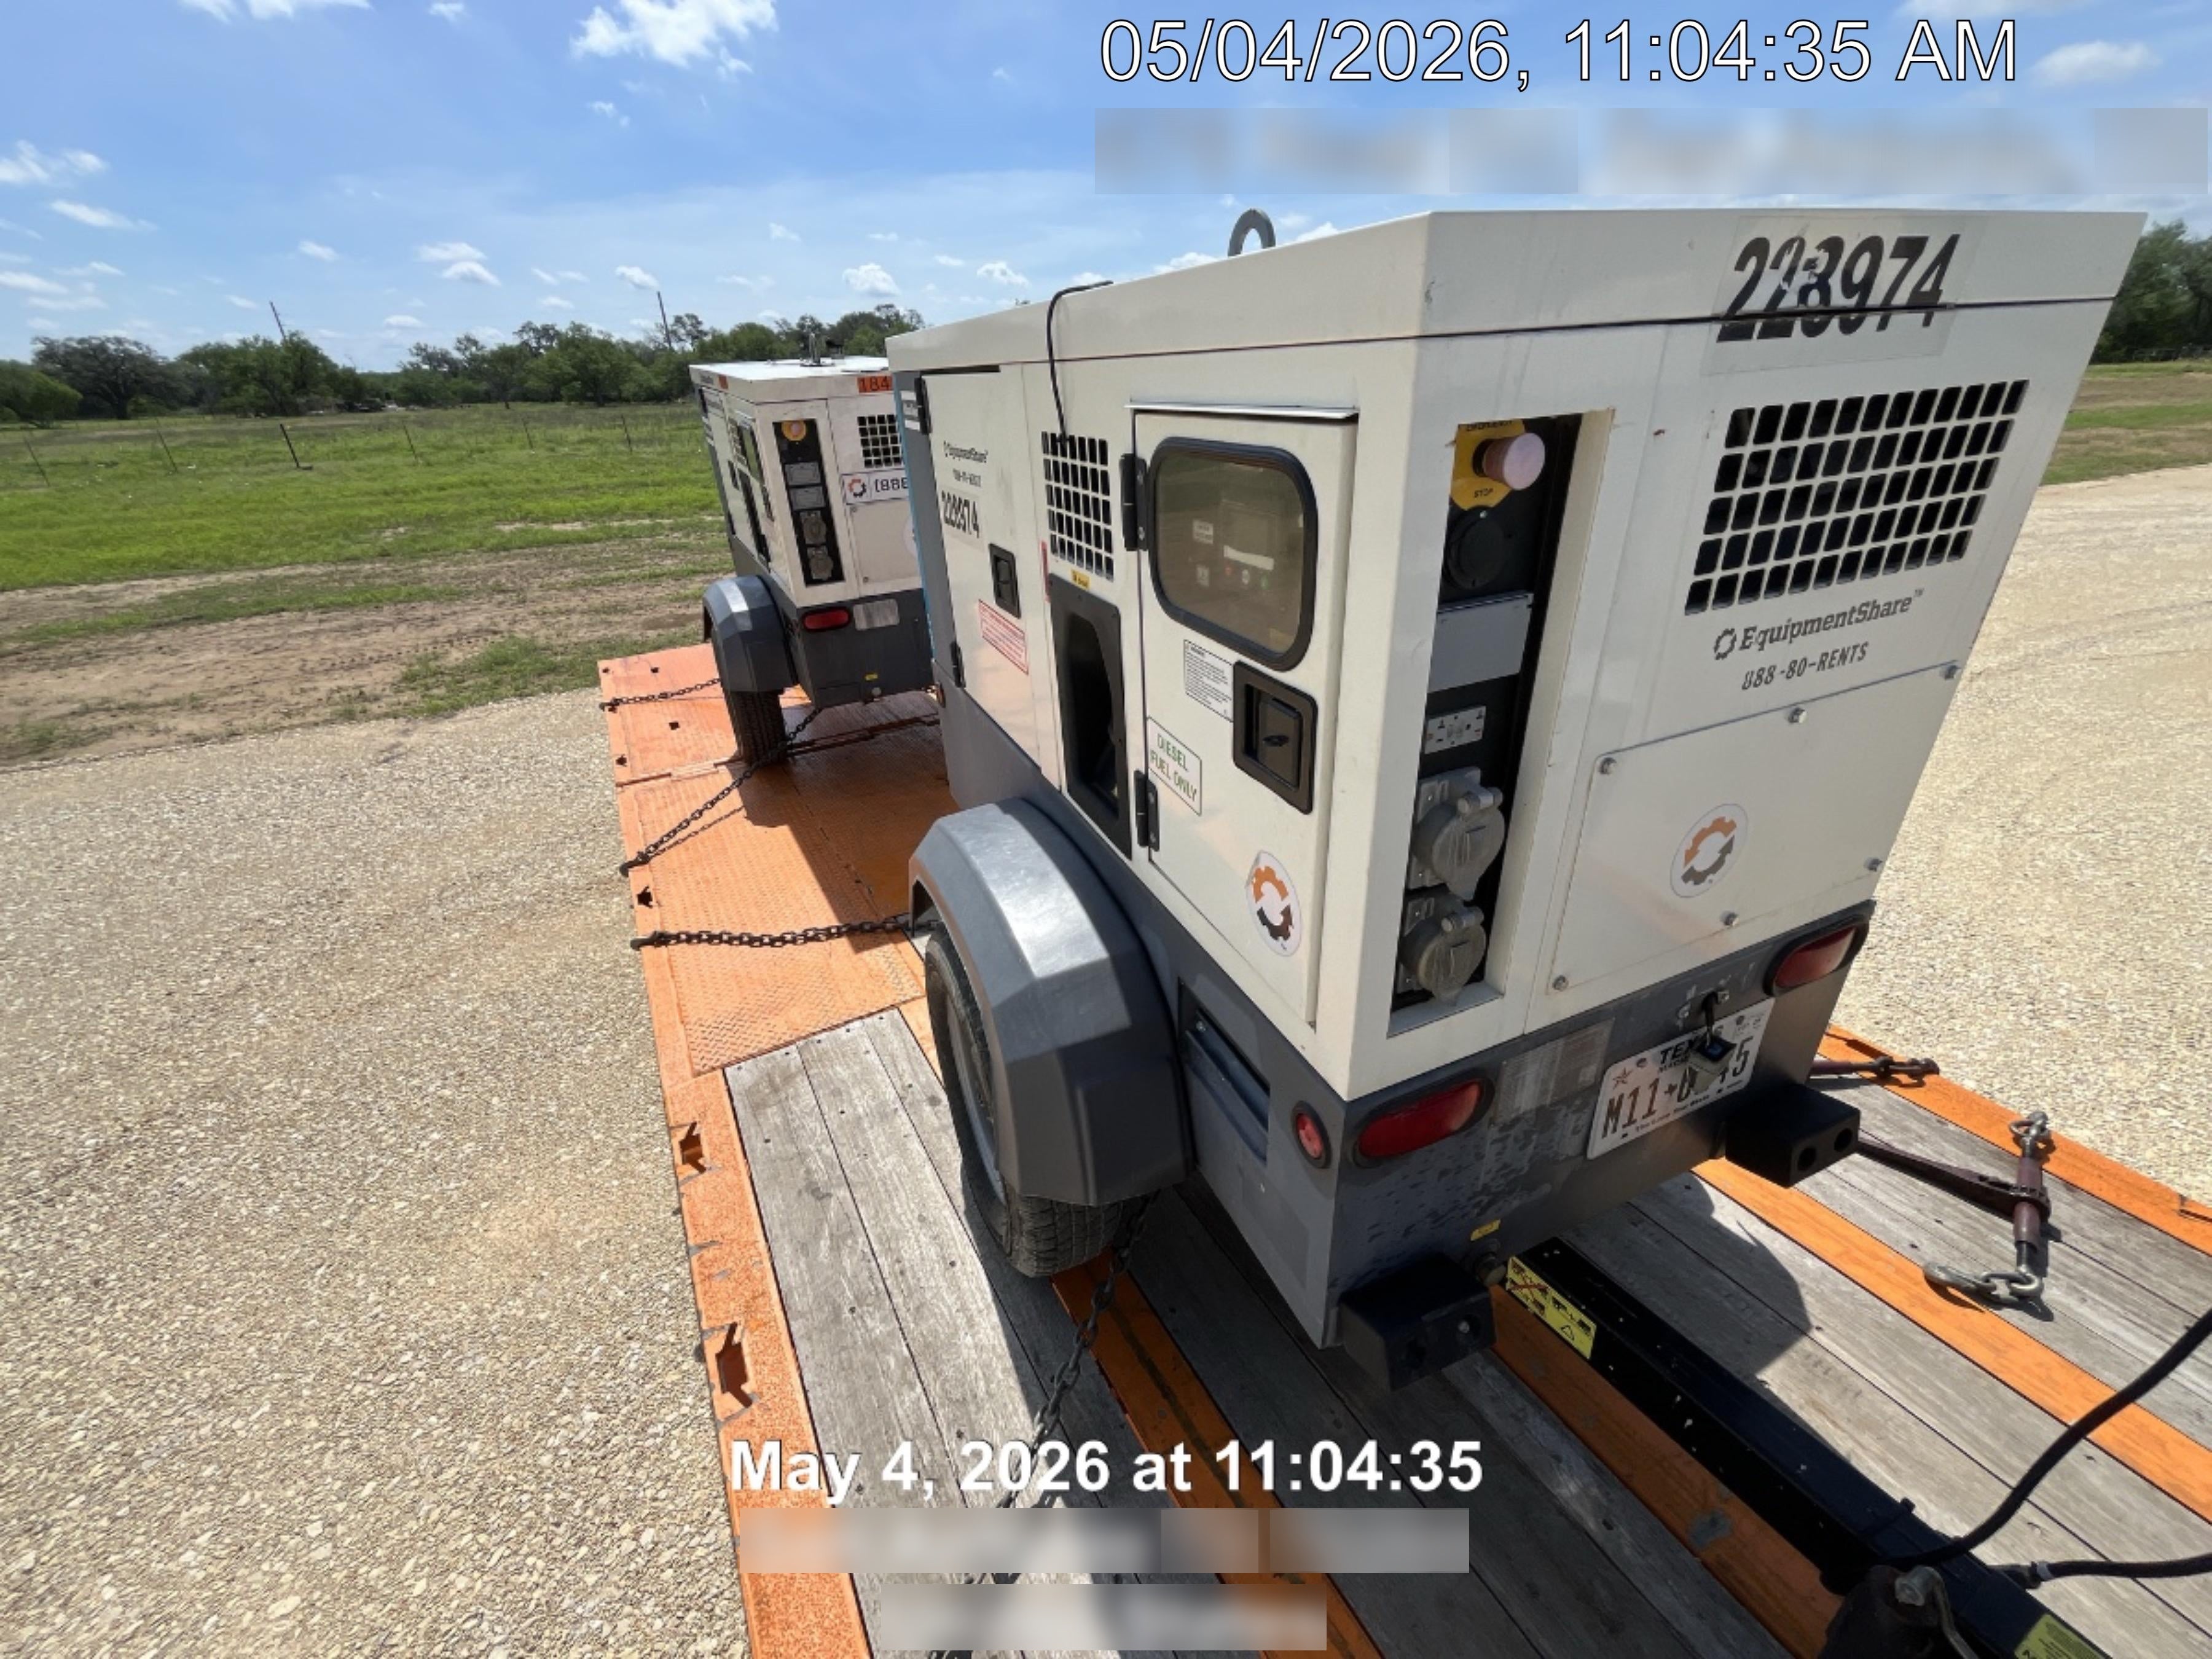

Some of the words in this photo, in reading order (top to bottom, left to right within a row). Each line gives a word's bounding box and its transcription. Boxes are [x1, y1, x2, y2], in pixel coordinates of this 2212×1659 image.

[1738, 596, 1913, 651] EquipmentShare
[1150, 749, 1171, 780] FUEL
[1174, 771, 1197, 802] ONLY
[1157, 733, 1188, 773] DIESEL
